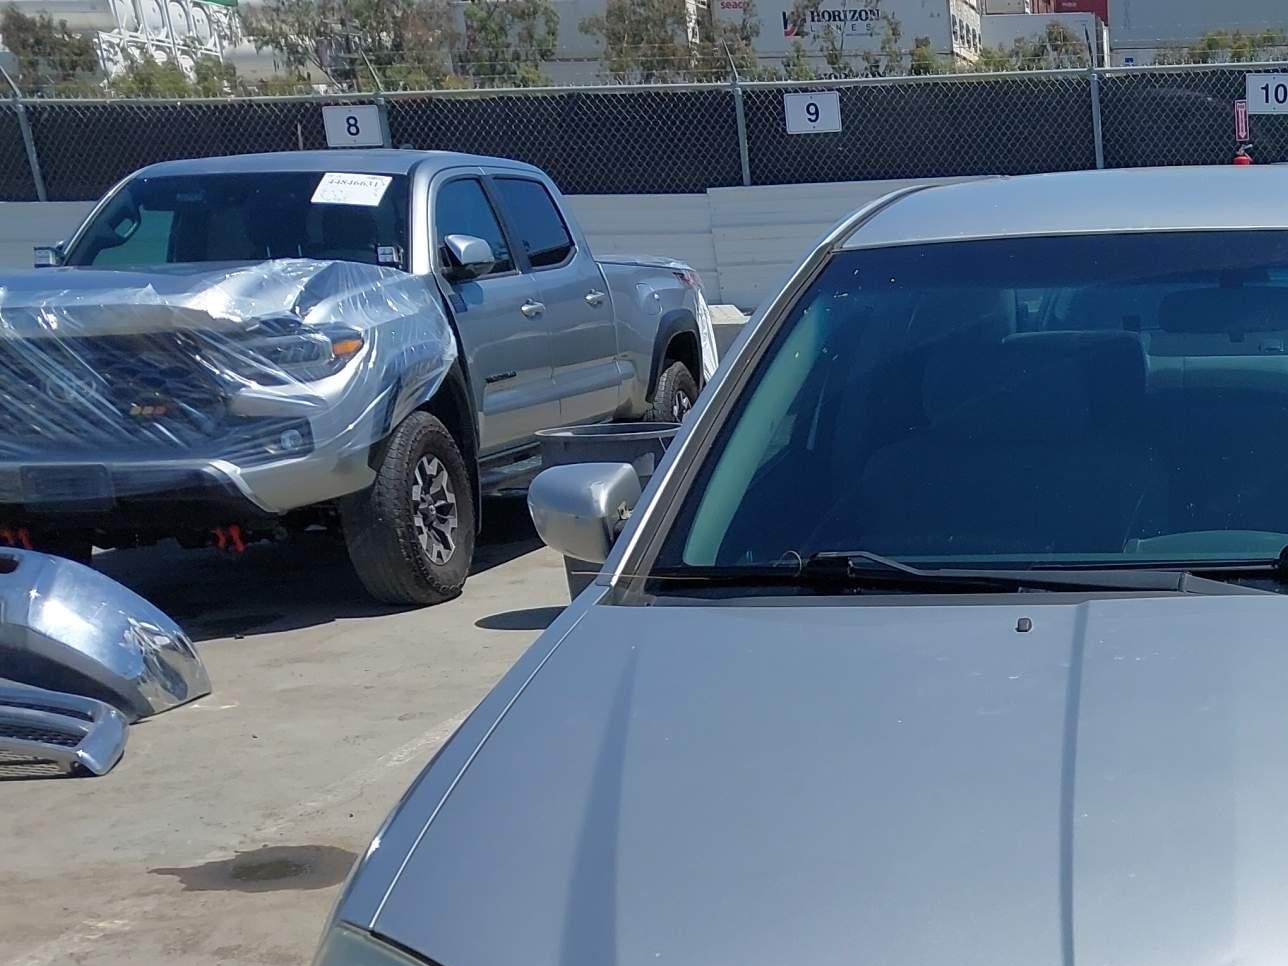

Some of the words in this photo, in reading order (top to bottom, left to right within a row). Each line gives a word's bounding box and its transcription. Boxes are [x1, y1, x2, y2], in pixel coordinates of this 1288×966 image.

[809, 8, 880, 22] HORIZON
[1260, 83, 1288, 104] 10
[806, 102, 820, 123] 9
[346, 116, 360, 136] 8
